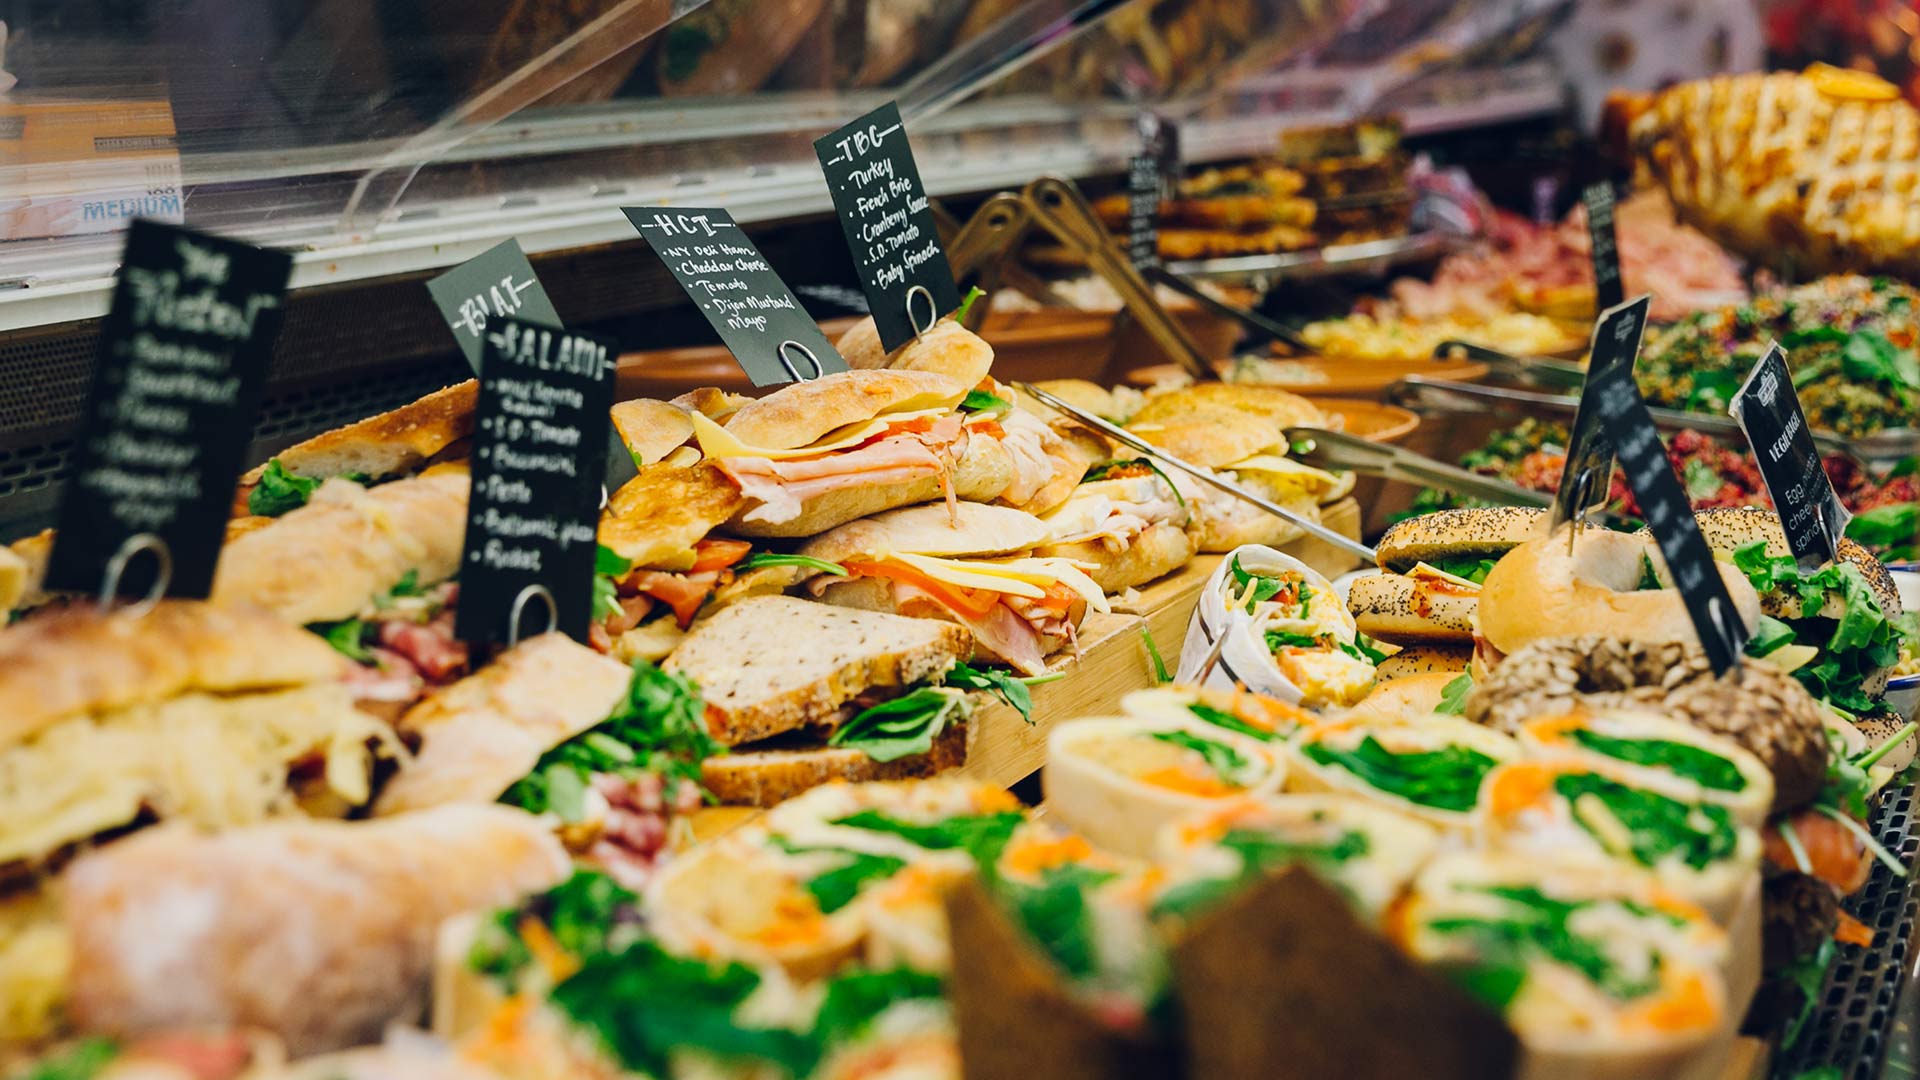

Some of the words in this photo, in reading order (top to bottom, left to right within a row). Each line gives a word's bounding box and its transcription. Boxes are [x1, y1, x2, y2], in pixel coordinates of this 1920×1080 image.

[848, 158, 894, 189] Turkey
[83, 194, 181, 220] MEDIUM
[856, 187, 890, 217] French
[889, 178, 912, 198] Brie
[654, 214, 717, 236] HCT
[863, 208, 908, 242] Cranberry
[885, 224, 920, 251] Tomato
[667, 247, 691, 258] NY
[719, 243, 755, 257] Ham
[681, 260, 733, 275] Cheddar
[876, 264, 905, 290] Baby
[903, 240, 940, 274] Spinach
[696, 278, 748, 296] Tomato
[713, 298, 746, 317] Dijon
[746, 294, 795, 310] Mustard
[728, 315, 767, 332] Mayo
[503, 322, 606, 381] SALAMI
[1785, 483, 1805, 505] Egg
[1789, 503, 1812, 531] chee
[1796, 519, 1821, 552] spina
